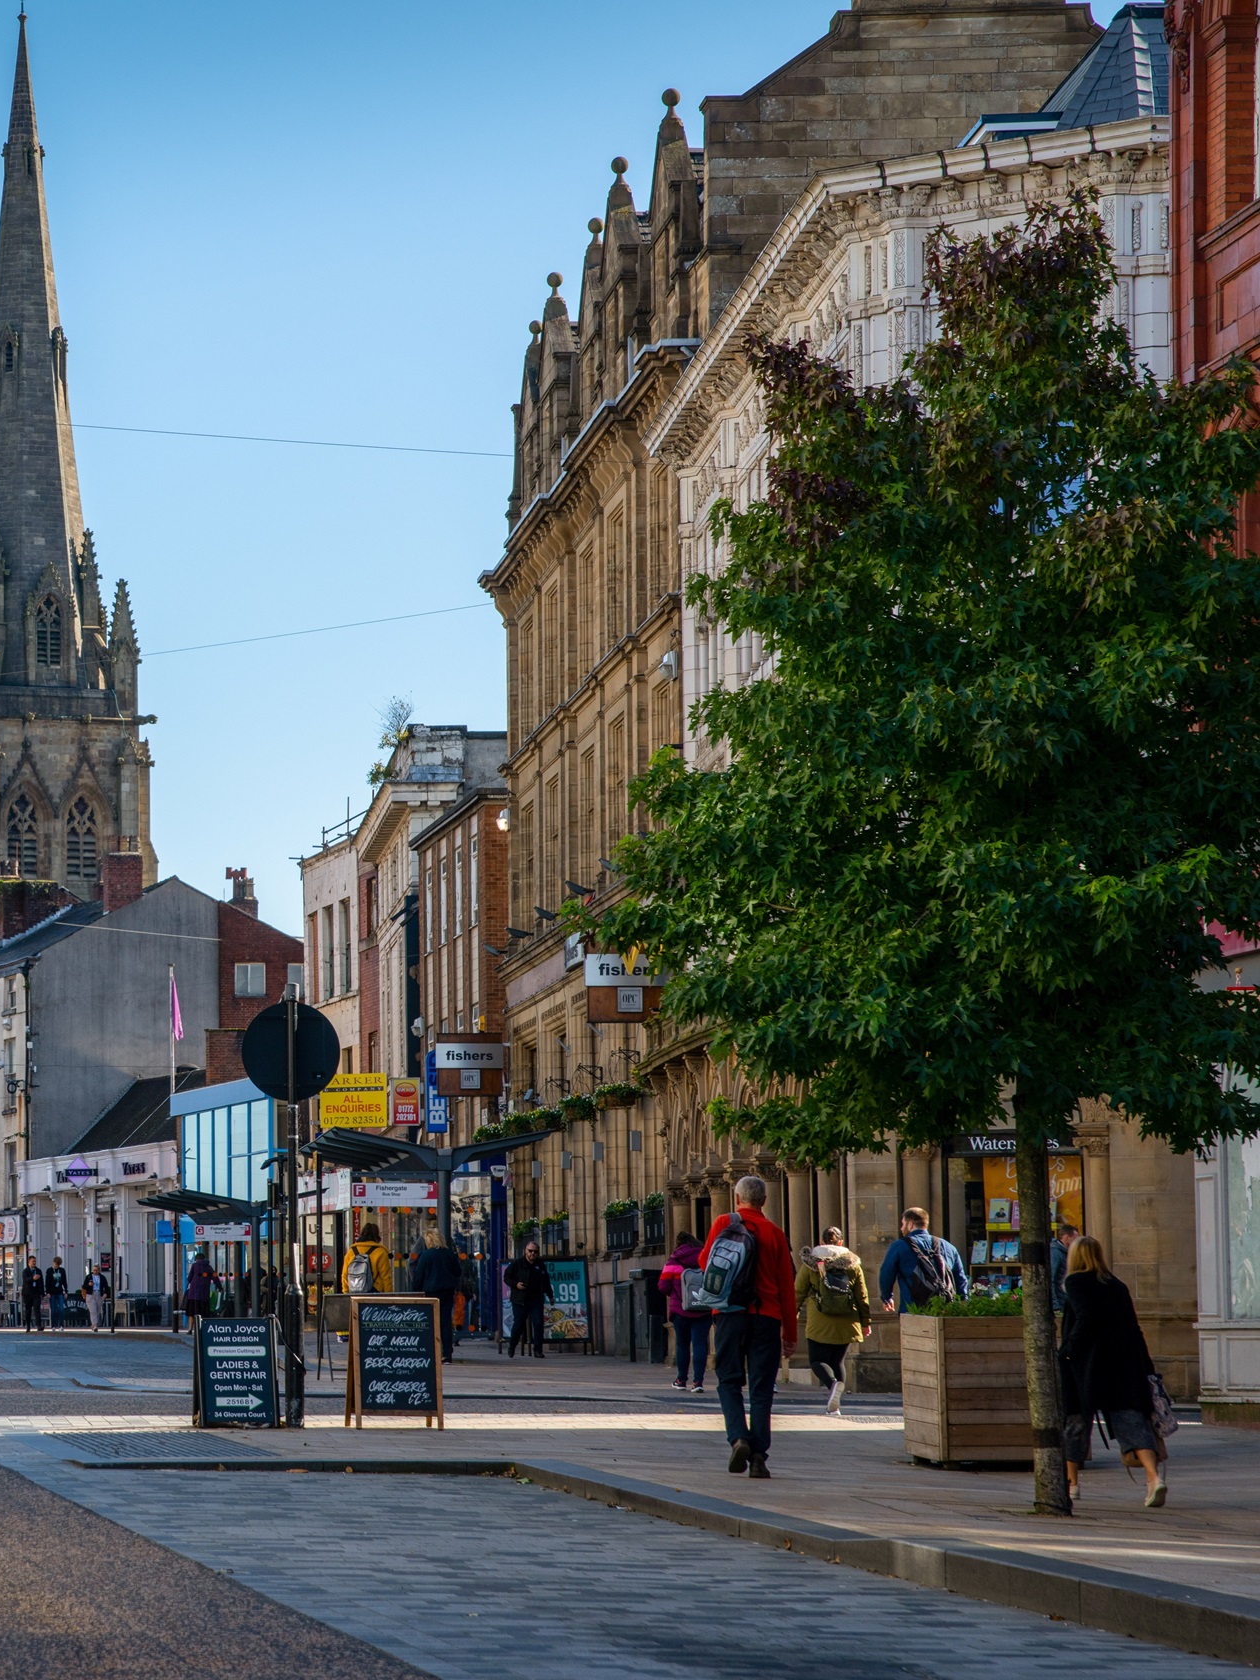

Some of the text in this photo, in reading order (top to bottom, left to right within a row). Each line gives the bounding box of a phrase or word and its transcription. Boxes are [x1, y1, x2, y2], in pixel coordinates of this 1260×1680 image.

[598, 963, 649, 976] fisher
[446, 1050, 493, 1061] fishers
[331, 1076, 383, 1085] ARKER
[343, 1095, 363, 1103] ALL
[325, 1103, 382, 1113] ENQUIRIES
[398, 1104, 414, 1113] 01772
[323, 1116, 385, 1125] 01772 823516
[968, 1136, 1060, 1151] Waterses
[355, 1185, 364, 1196] F
[196, 1226, 203, 1235] G
[549, 1283, 579, 1302] .99
[361, 1306, 427, 1324] Wellington
[207, 1325, 266, 1334] Alan Joyce
[390, 1335, 420, 1346] MENU
[216, 1361, 259, 1369] LADIES &
[364, 1357, 431, 1369] BEER GARDEN
[209, 1371, 266, 1379] GENTS HAIR
[214, 1384, 232, 1392] Open
[368, 1380, 427, 1393] CARLSBERG
